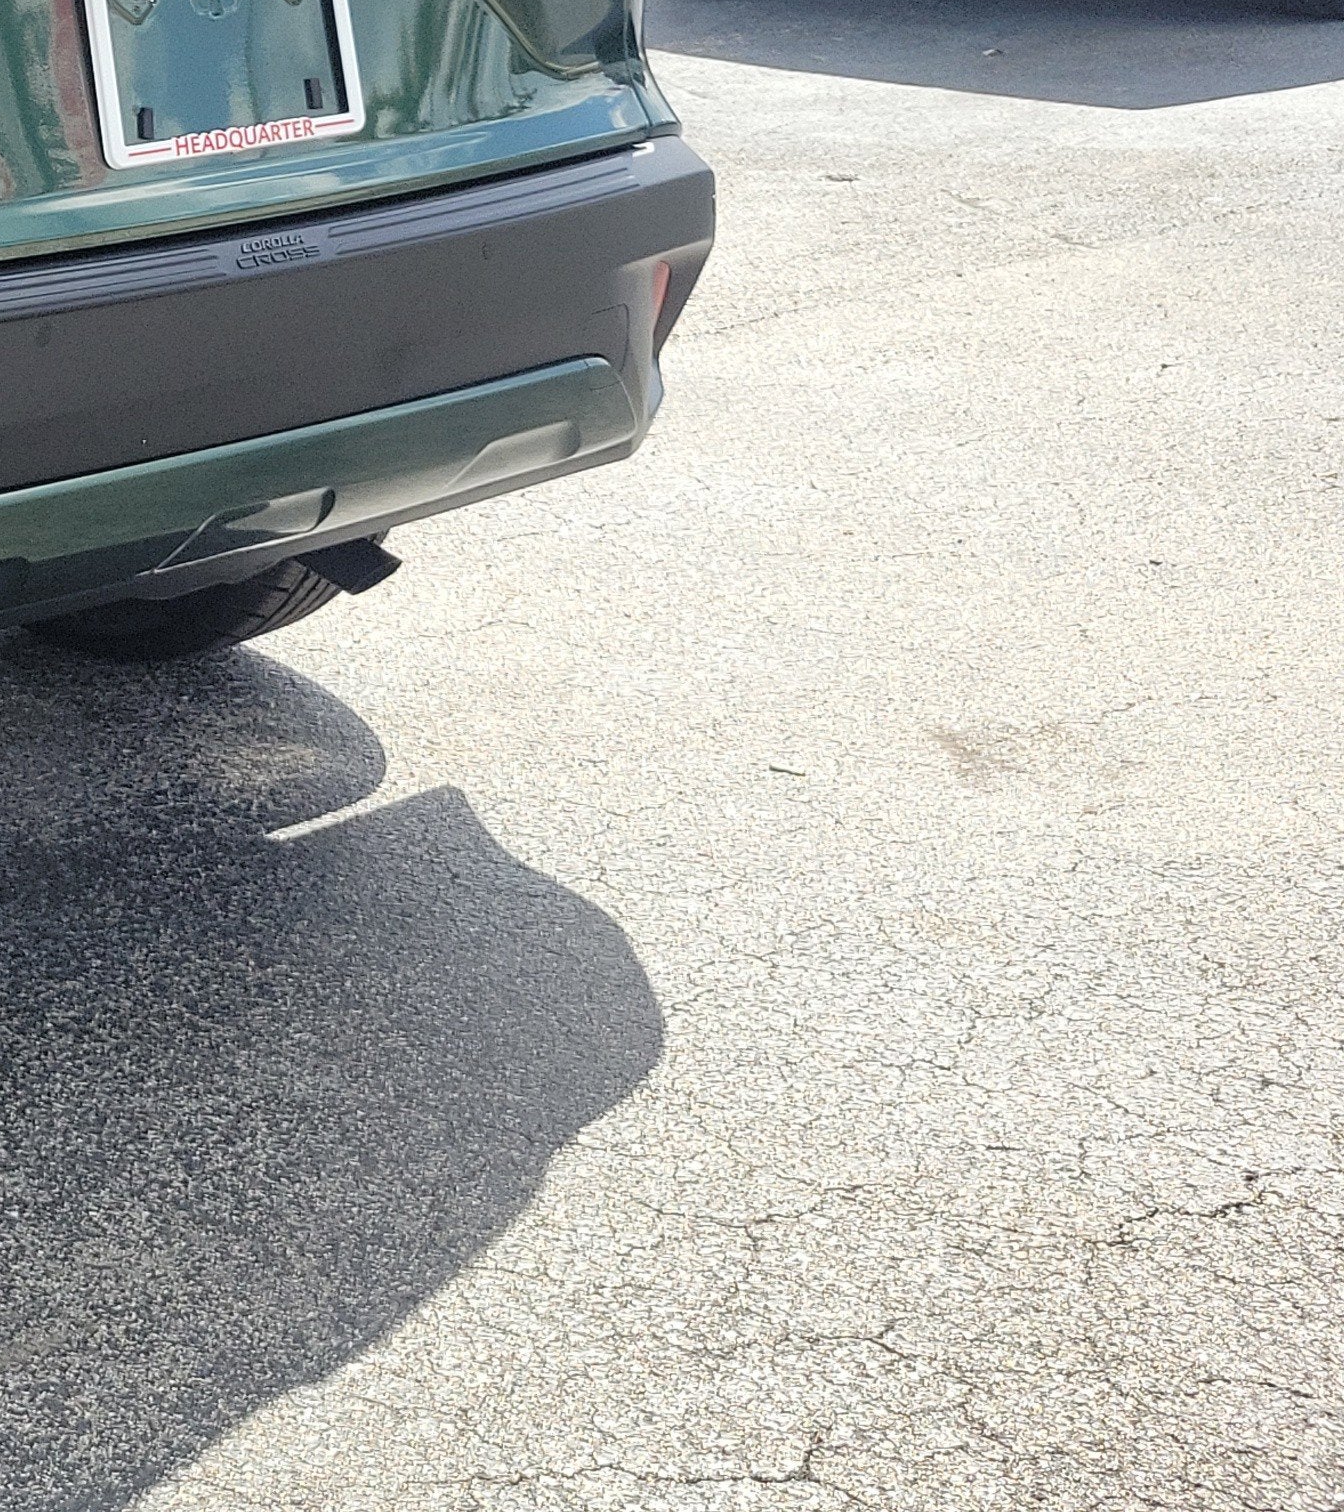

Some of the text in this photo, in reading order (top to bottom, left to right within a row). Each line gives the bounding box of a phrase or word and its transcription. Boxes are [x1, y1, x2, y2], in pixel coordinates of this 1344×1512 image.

[175, 118, 314, 156] HEADQUARTER
[240, 234, 304, 254] COROLLA
[236, 245, 321, 269] CROSS
